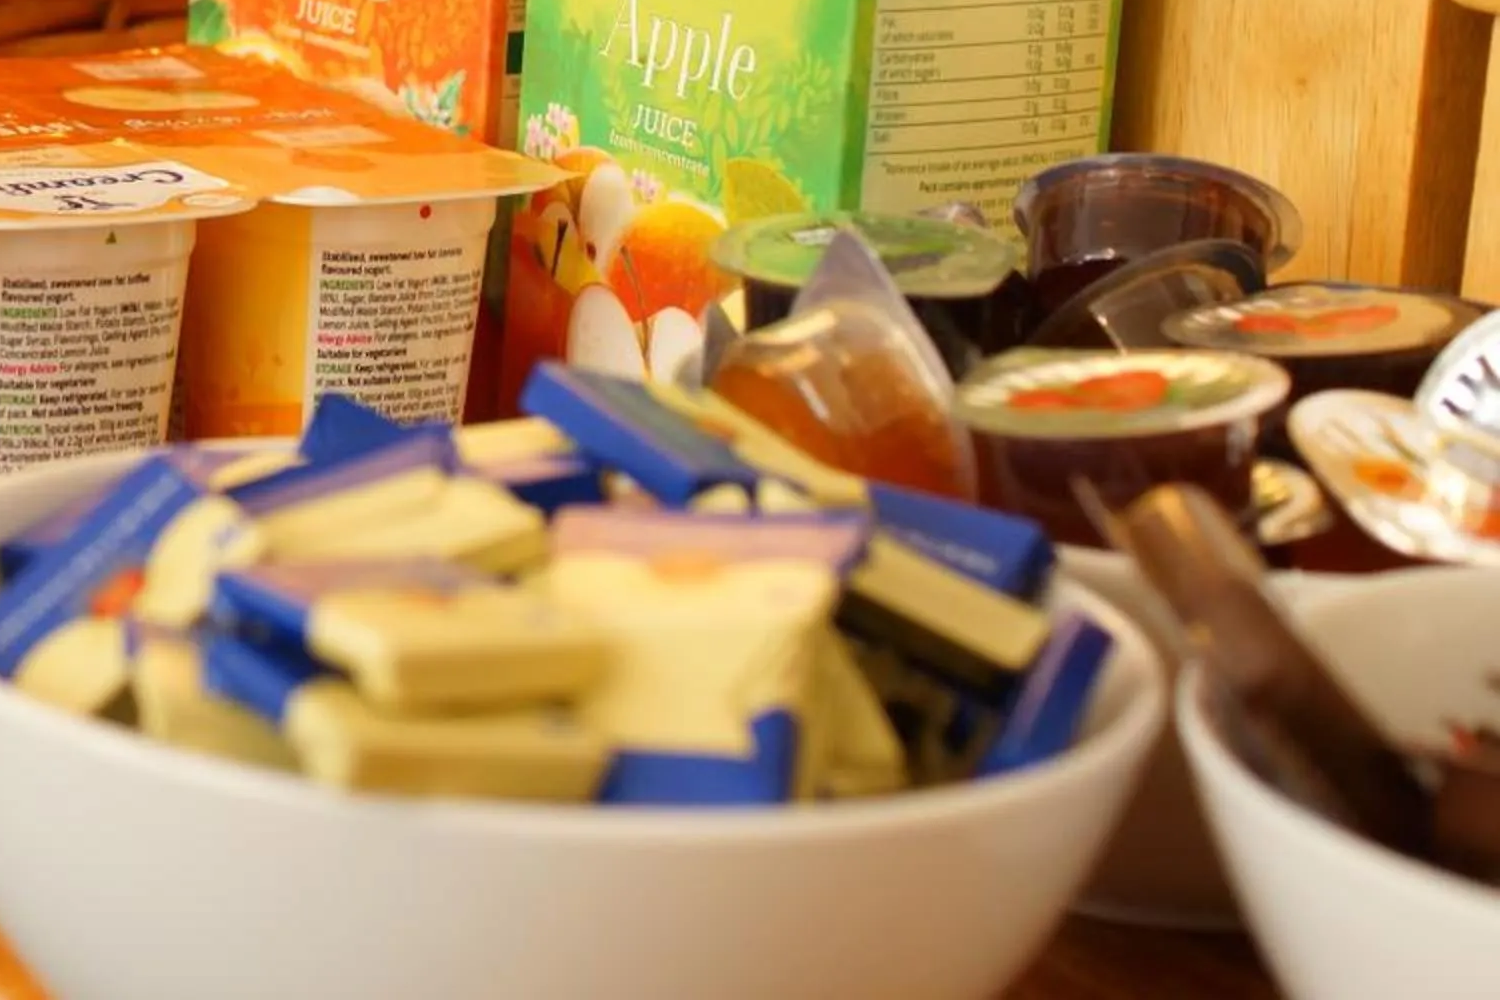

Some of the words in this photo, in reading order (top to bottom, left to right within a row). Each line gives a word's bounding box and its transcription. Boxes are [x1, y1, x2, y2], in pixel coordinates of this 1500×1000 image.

[632, 103, 698, 146] JUICE
[1, 292, 44, 303] flavoured
[317, 349, 350, 359] Suitable
[36, 378, 49, 389] for
[51, 377, 96, 391] vegetarians
[32, 406, 47, 418] Not
